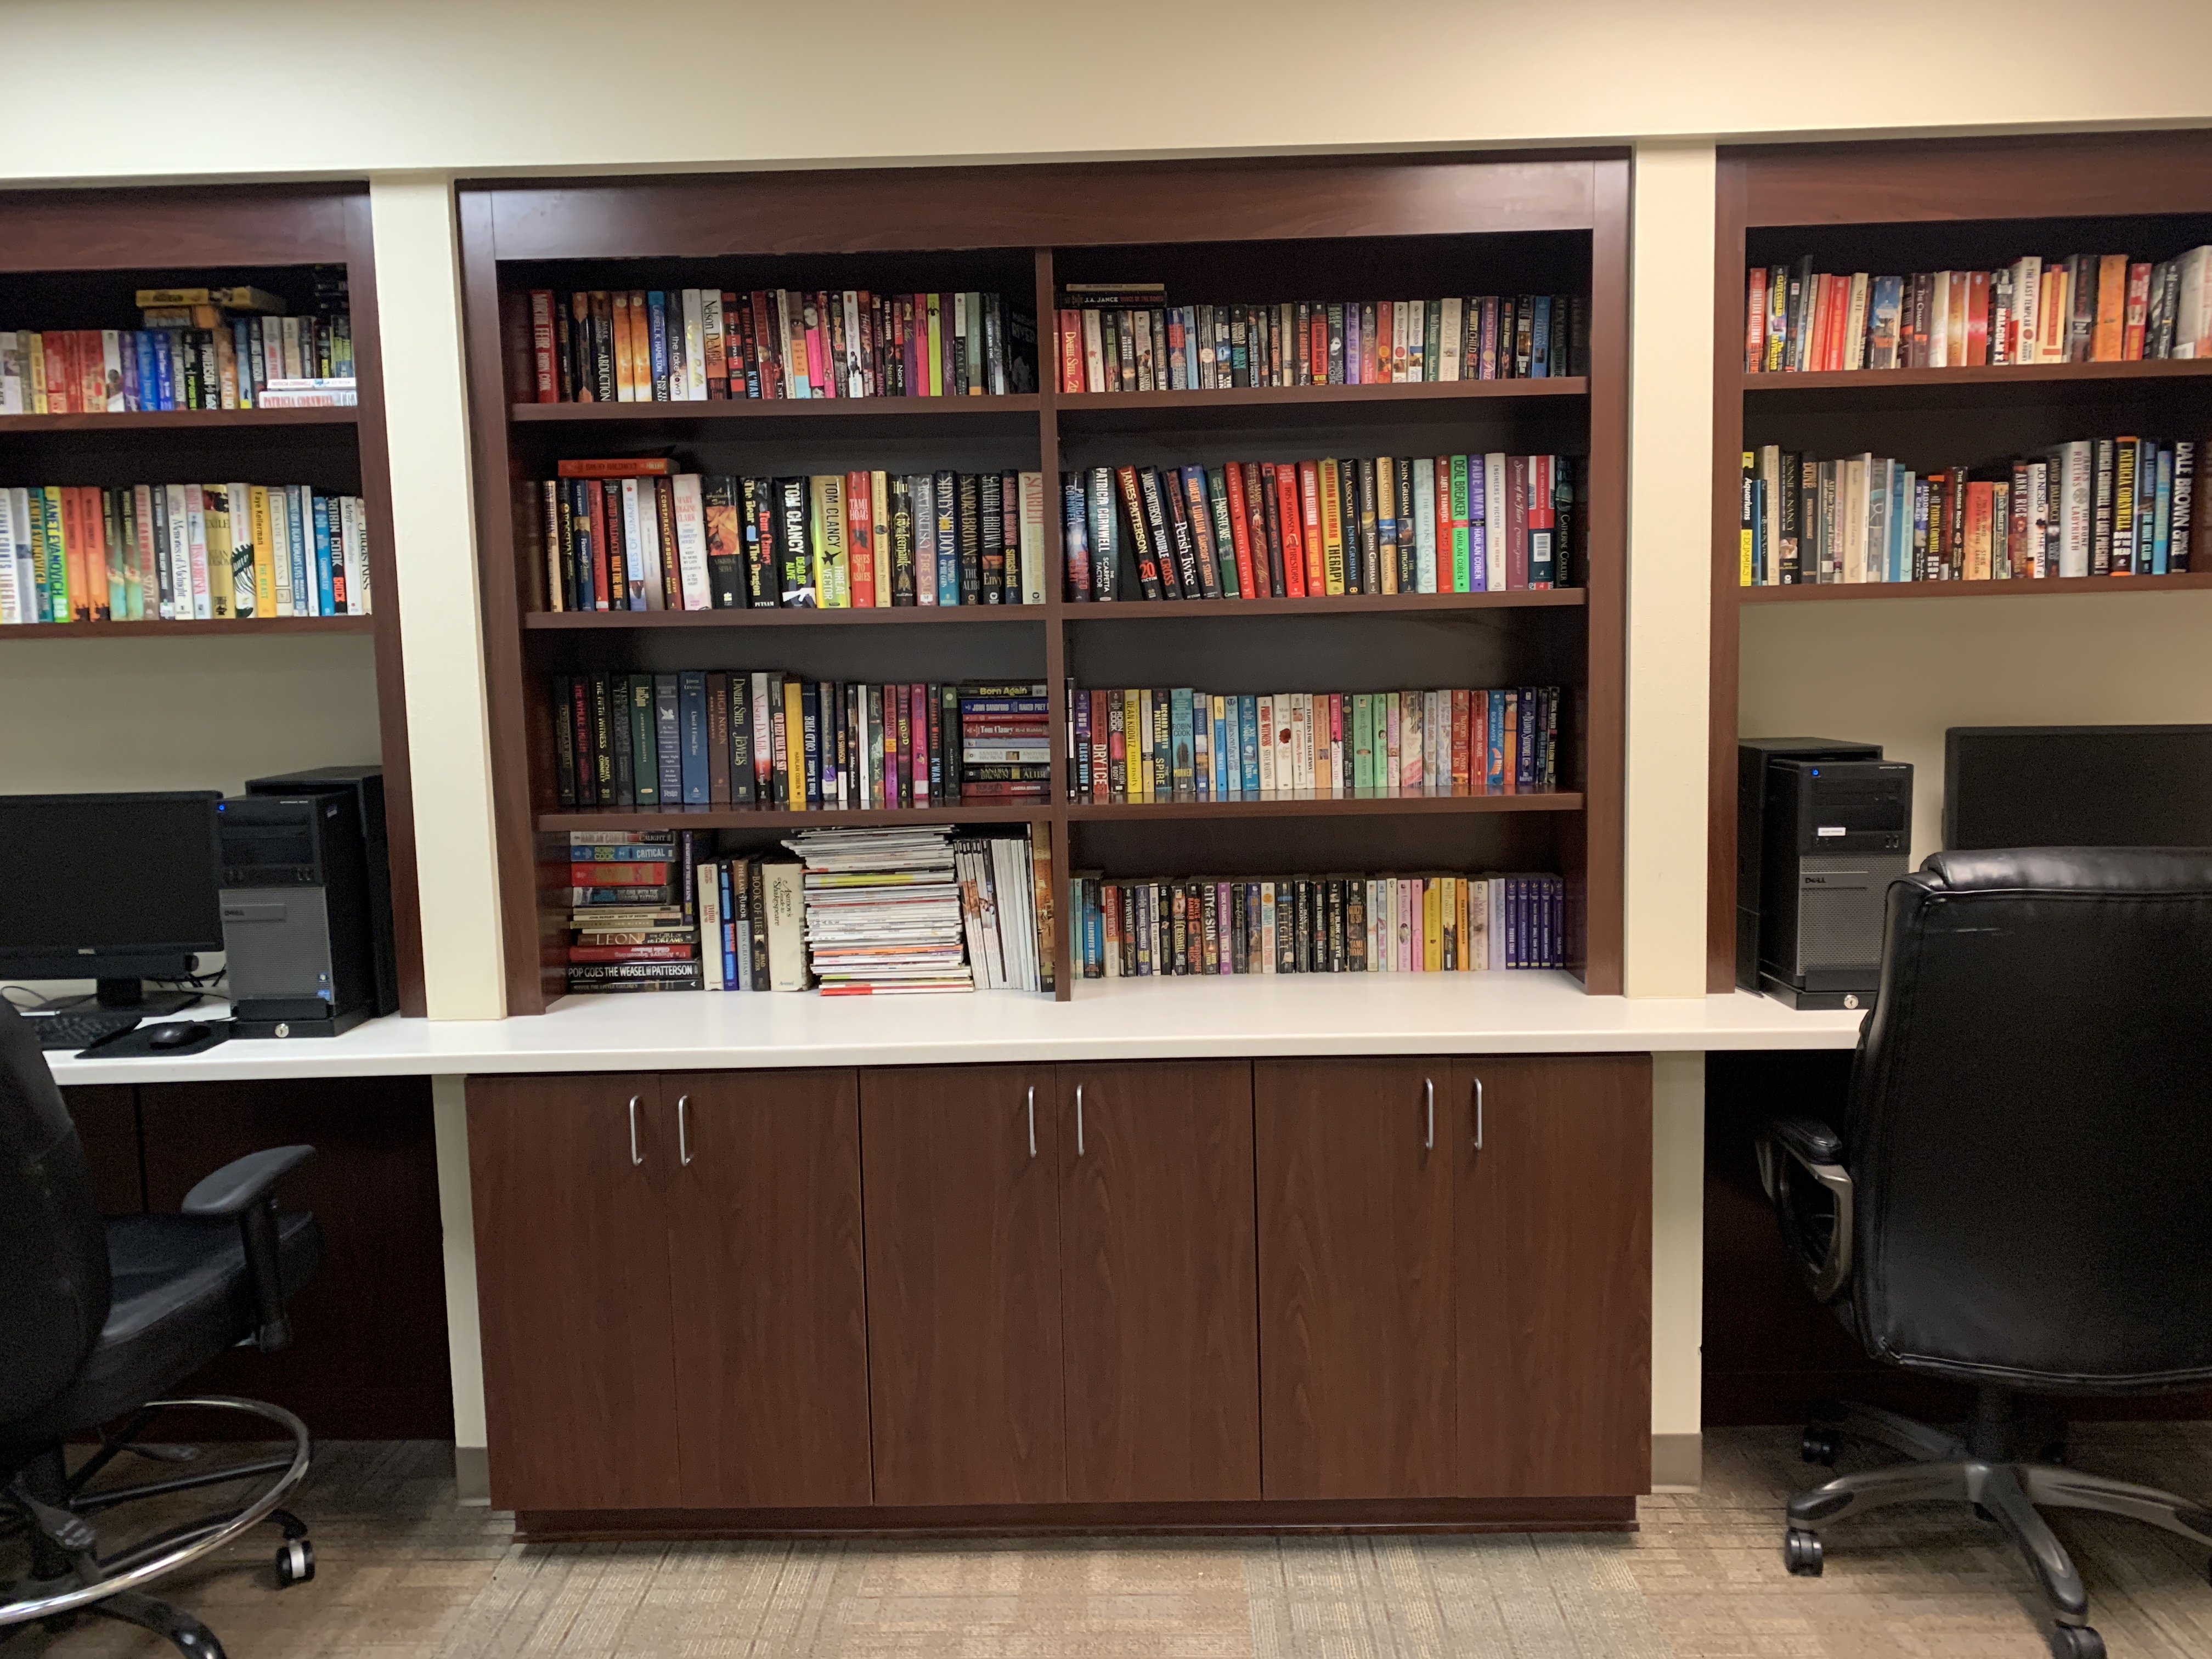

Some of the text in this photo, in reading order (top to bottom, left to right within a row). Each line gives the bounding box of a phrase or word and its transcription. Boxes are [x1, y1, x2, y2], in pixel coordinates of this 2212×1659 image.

[2023, 268, 2034, 327] THE LAST TEMPLAR
[532, 294, 551, 392] MORTAL FEAR ROBIN COOK
[703, 301, 723, 366] Nelson DeMille
[1299, 334, 1308, 360] GARDNER
[1469, 332, 1477, 353] CHILD
[1995, 308, 2007, 352] MALCOLM
[1065, 331, 1078, 377] DANIELLE STEEL
[1770, 334, 1779, 370] NAVIGATOR
[597, 353, 611, 401] ABDUCTION
[263, 395, 334, 408] PATRICIA CORNWELL
[1454, 460, 1465, 479] DEAL
[1472, 459, 1485, 485] FADE
[1803, 462, 1813, 489] DUNE
[2072, 451, 2082, 487] ROLLINS
[2173, 442, 2194, 527] DALE BROWN
[849, 499, 868, 510] TAMI
[1454, 481, 1466, 517] BREAKER
[1474, 488, 1485, 516] AWAY
[2015, 473, 2027, 517] ANNE RICE
[2117, 449, 2134, 529] PATRICIA CORNWELL
[345, 502, 354, 523] Adrift
[661, 495, 669, 535] CONSPIRACY
[784, 482, 804, 554] TOM CLANCY
[825, 483, 840, 548] TOM CLANCY
[1095, 467, 1110, 552] PATRICIA CORNWELL
[1121, 471, 1148, 554] JAMES PATTERSON
[1324, 462, 1342, 583] JONATHAN KELLERMAN THERAPY
[29, 498, 46, 584] JANET EVANOVICH
[46, 499, 64, 596] JANET EVANOVICH
[255, 510, 263, 545] Kellerman
[260, 578, 268, 599] BEAST
[664, 537, 671, 546] OF
[758, 510, 773, 566] Tom Clancy
[1175, 522, 1197, 586] Perish Twice
[172, 520, 188, 597] Memories of Midnight
[664, 548, 673, 569] BONES
[748, 544, 761, 596] The Dragon
[785, 562, 796, 580] ALIVE
[795, 556, 806, 585] DEAD OR
[822, 568, 833, 600] VECTOR
[834, 565, 845, 595] THREAT
[717, 690, 725, 713] HIGH
[1003, 687, 1028, 696] Again
[598, 718, 607, 749] WITNESS
[754, 694, 767, 754] Nelson DeMille
[838, 730, 847, 764] KIKI SWINSON
[1127, 701, 1139, 787] DEAN KOONTZ intensity
[1079, 743, 1089, 784] BLACK WIDOW
[1093, 744, 1107, 785] DRY ICE
[1155, 758, 1164, 785] SPIRE
[636, 848, 665, 858] CRITICAL
[752, 876, 763, 934] BOOK OF LIES
[772, 877, 782, 927] Shakespeare
[1204, 885, 1215, 907] CITY
[596, 933, 640, 945] LEON
[1205, 918, 1216, 941] SUN
[568, 966, 692, 977] POP GOES THE WEASEL PATTERSON
